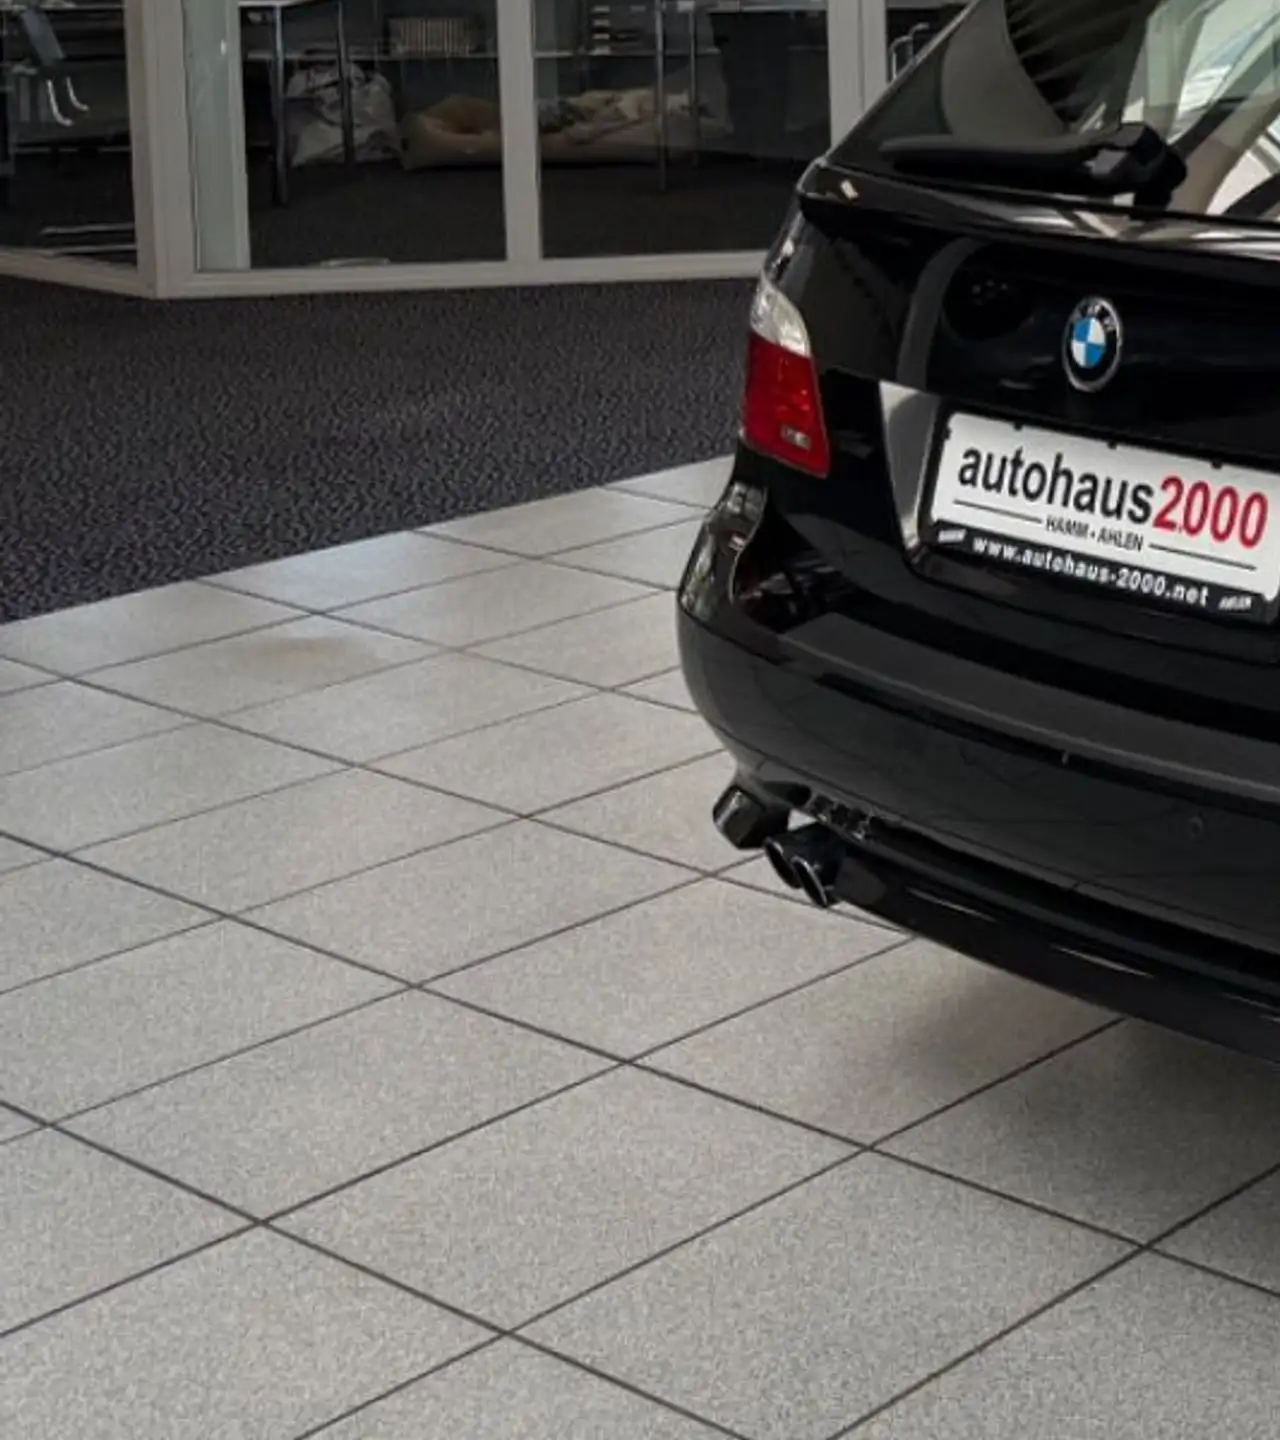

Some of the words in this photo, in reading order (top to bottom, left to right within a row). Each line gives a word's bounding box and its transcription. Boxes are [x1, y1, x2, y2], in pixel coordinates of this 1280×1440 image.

[1046, 515, 1089, 538] HAMM
[1096, 526, 1143, 552] AHLEN
[972, 536, 1209, 607] www.autohaus-2000.net
